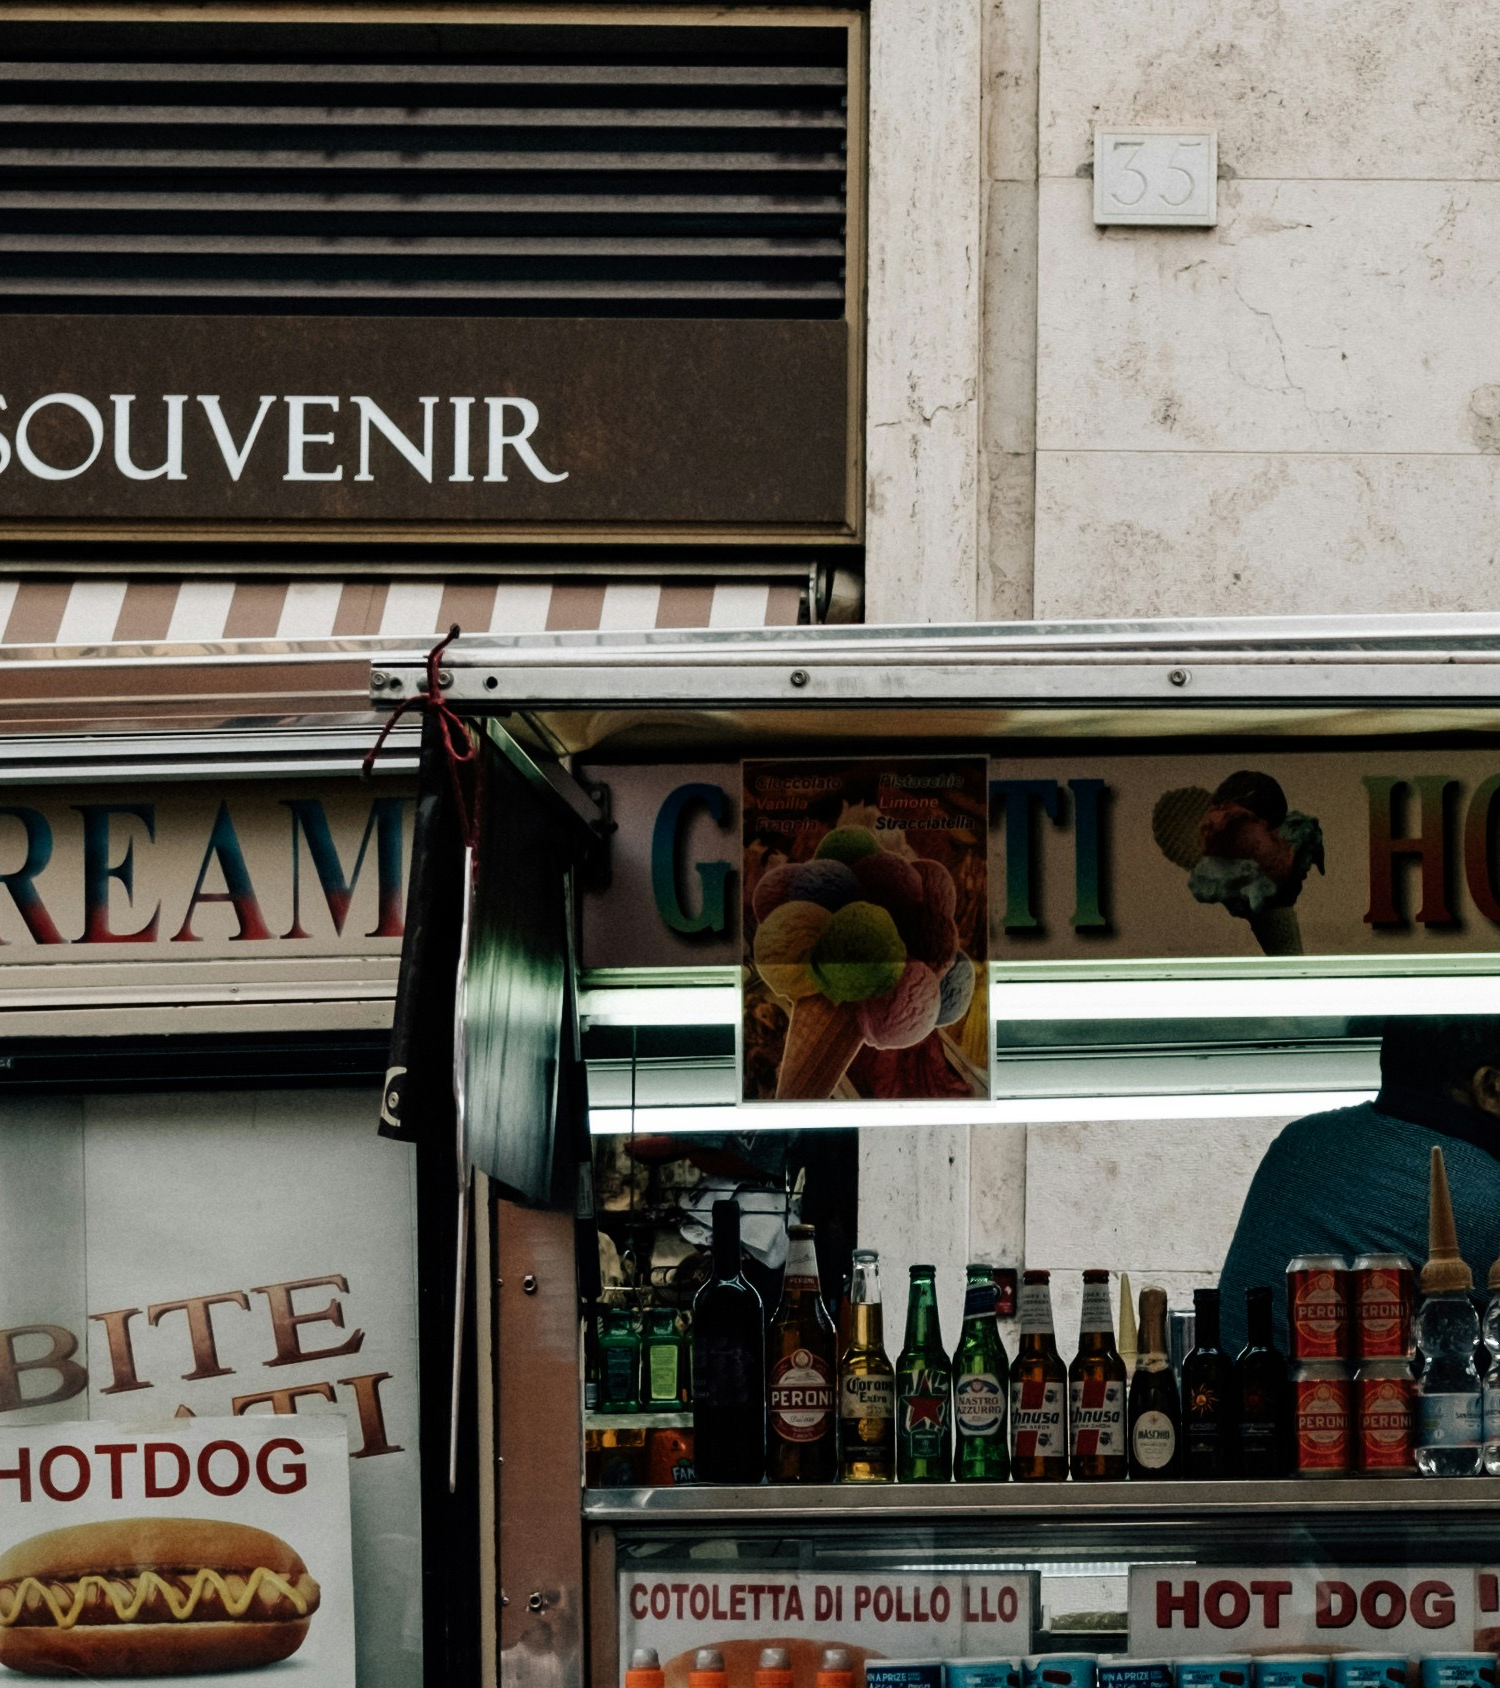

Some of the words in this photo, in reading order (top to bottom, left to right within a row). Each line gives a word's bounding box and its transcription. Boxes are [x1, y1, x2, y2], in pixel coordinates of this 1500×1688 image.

[1108, 141, 1198, 207] 35
[754, 775, 843, 792] Cioccolato
[878, 773, 965, 790] Pistacchio
[756, 796, 809, 811] Vanilla
[879, 796, 939, 809] Limone
[875, 816, 975, 831] Stracciatella
[770, 1390, 833, 1407] PERONI
[859, 1394, 887, 1404] Extra
[959, 1396, 999, 1406] NASTRO
[1011, 1411, 1060, 1425] hnusa
[1070, 1410, 1120, 1424] hnusa
[1298, 1415, 1348, 1429] PERONI
[1363, 1415, 1412, 1429] PERONI
[629, 1583, 804, 1621] COTOLETTA
[814, 1583, 843, 1622] DI
[854, 1585, 951, 1623] POLLO
[1155, 1579, 1292, 1628] HOT
[1315, 1579, 1457, 1628] DOG
